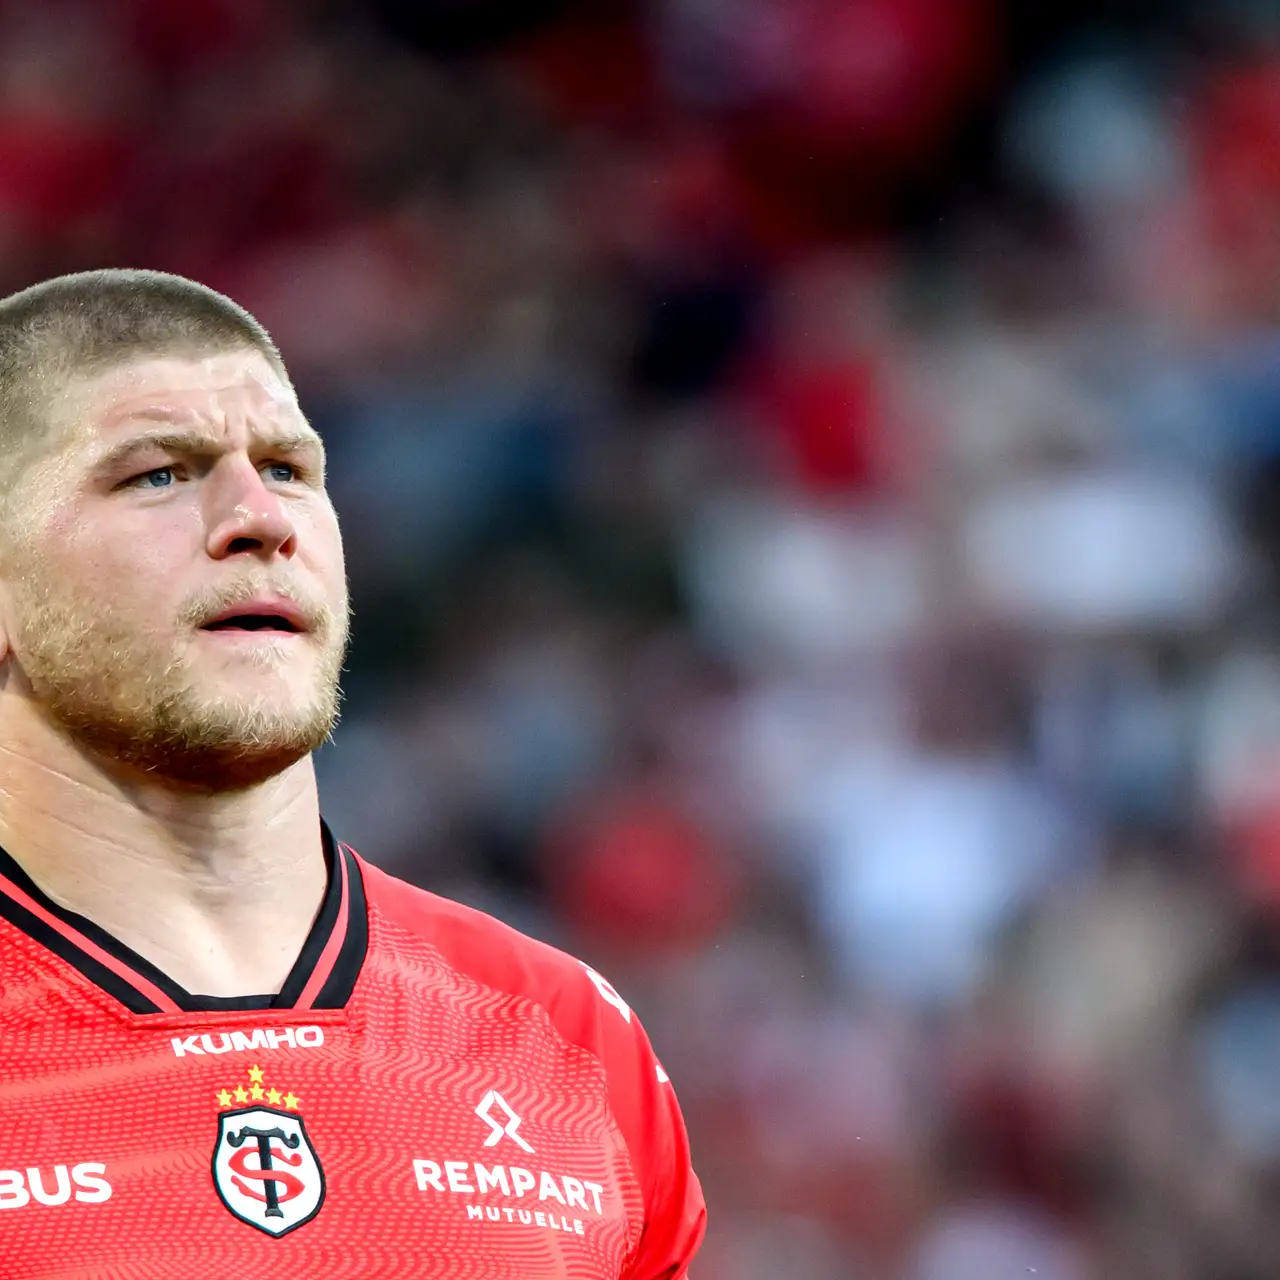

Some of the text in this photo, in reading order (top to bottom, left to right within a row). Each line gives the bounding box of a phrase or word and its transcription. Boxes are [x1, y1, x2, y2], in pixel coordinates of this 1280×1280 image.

[171, 1026, 324, 1057] KUMHO
[413, 1159, 604, 1215] REMPART
[466, 1205, 584, 1235] MUTUELLE
